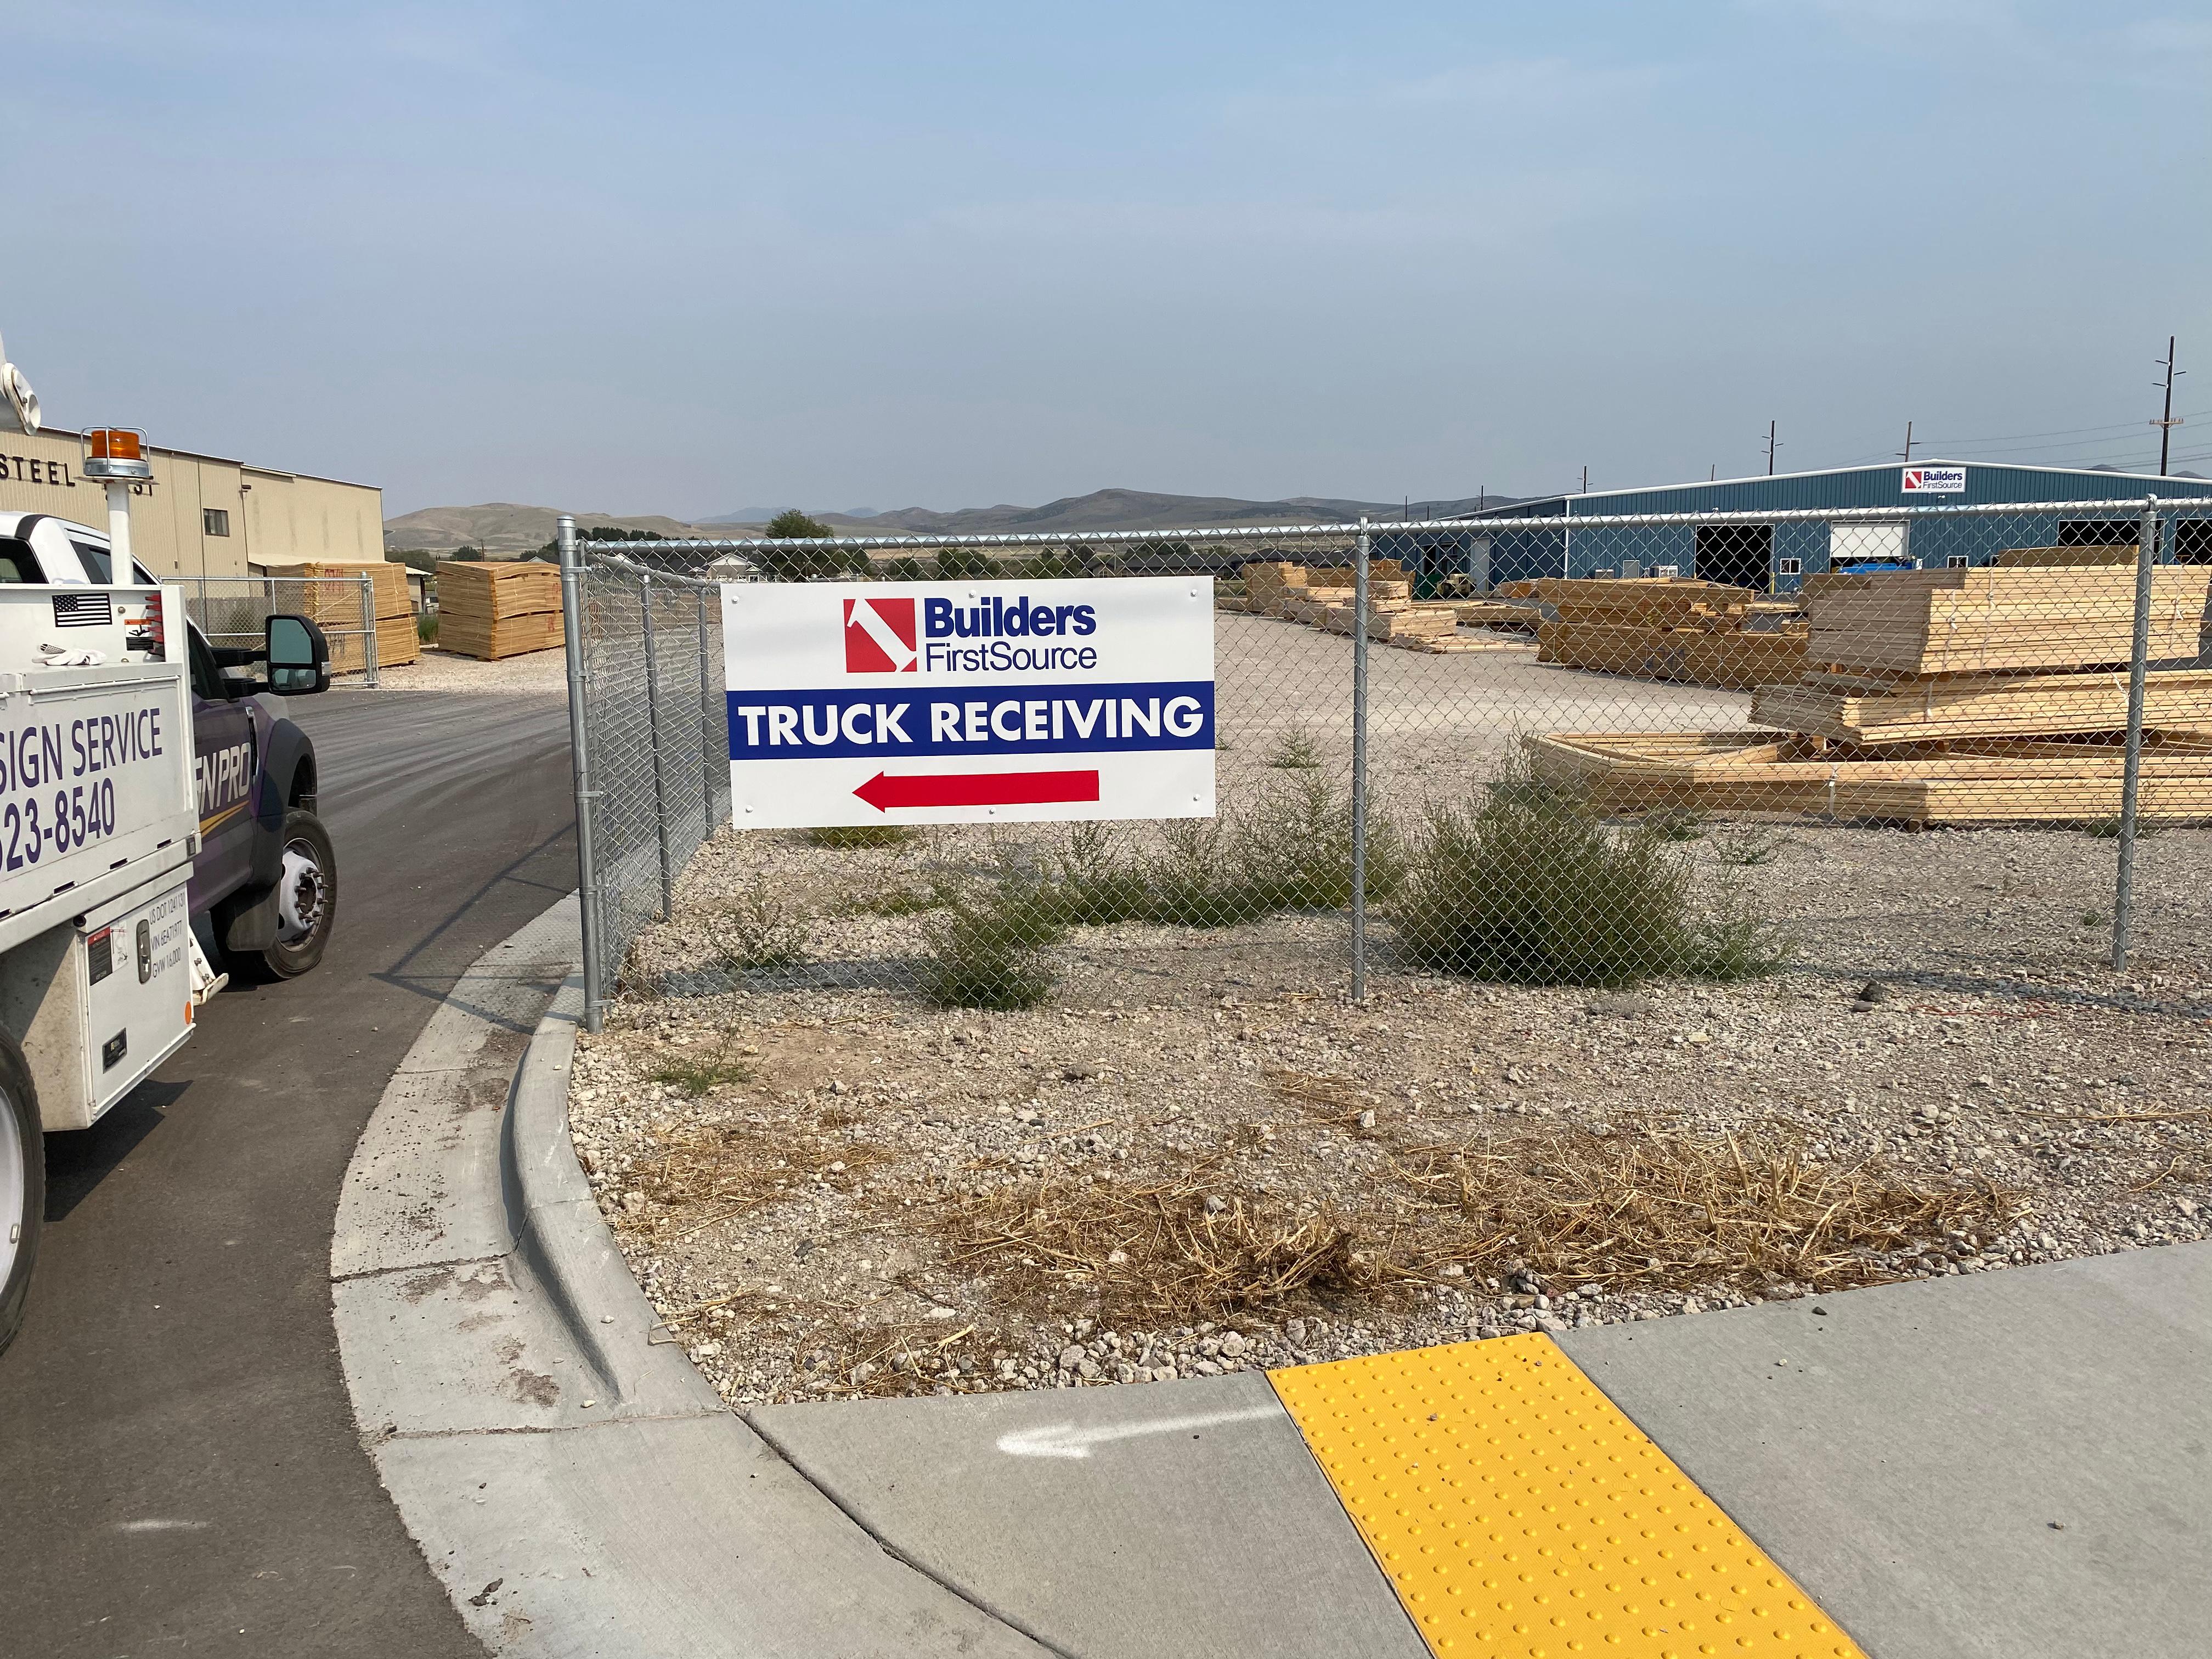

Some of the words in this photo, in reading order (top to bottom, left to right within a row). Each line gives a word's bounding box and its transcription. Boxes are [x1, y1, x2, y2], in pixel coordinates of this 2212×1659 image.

[0, 454, 75, 486] STEEL
[1923, 471, 1962, 481] Builders
[1923, 481, 1962, 489] FirstSource
[924, 596, 1097, 638] Builders
[926, 641, 1097, 672] FirstSource
[738, 703, 913, 746] TRUCK
[931, 696, 1204, 742] RECEIVING
[71, 707, 162, 777] SERVICE
[0, 777, 115, 872] 23-8540
[149, 908, 156, 925] US
[156, 902, 167, 921] DOT
[150, 934, 160, 951] VIN
[153, 956, 165, 978] GVW
